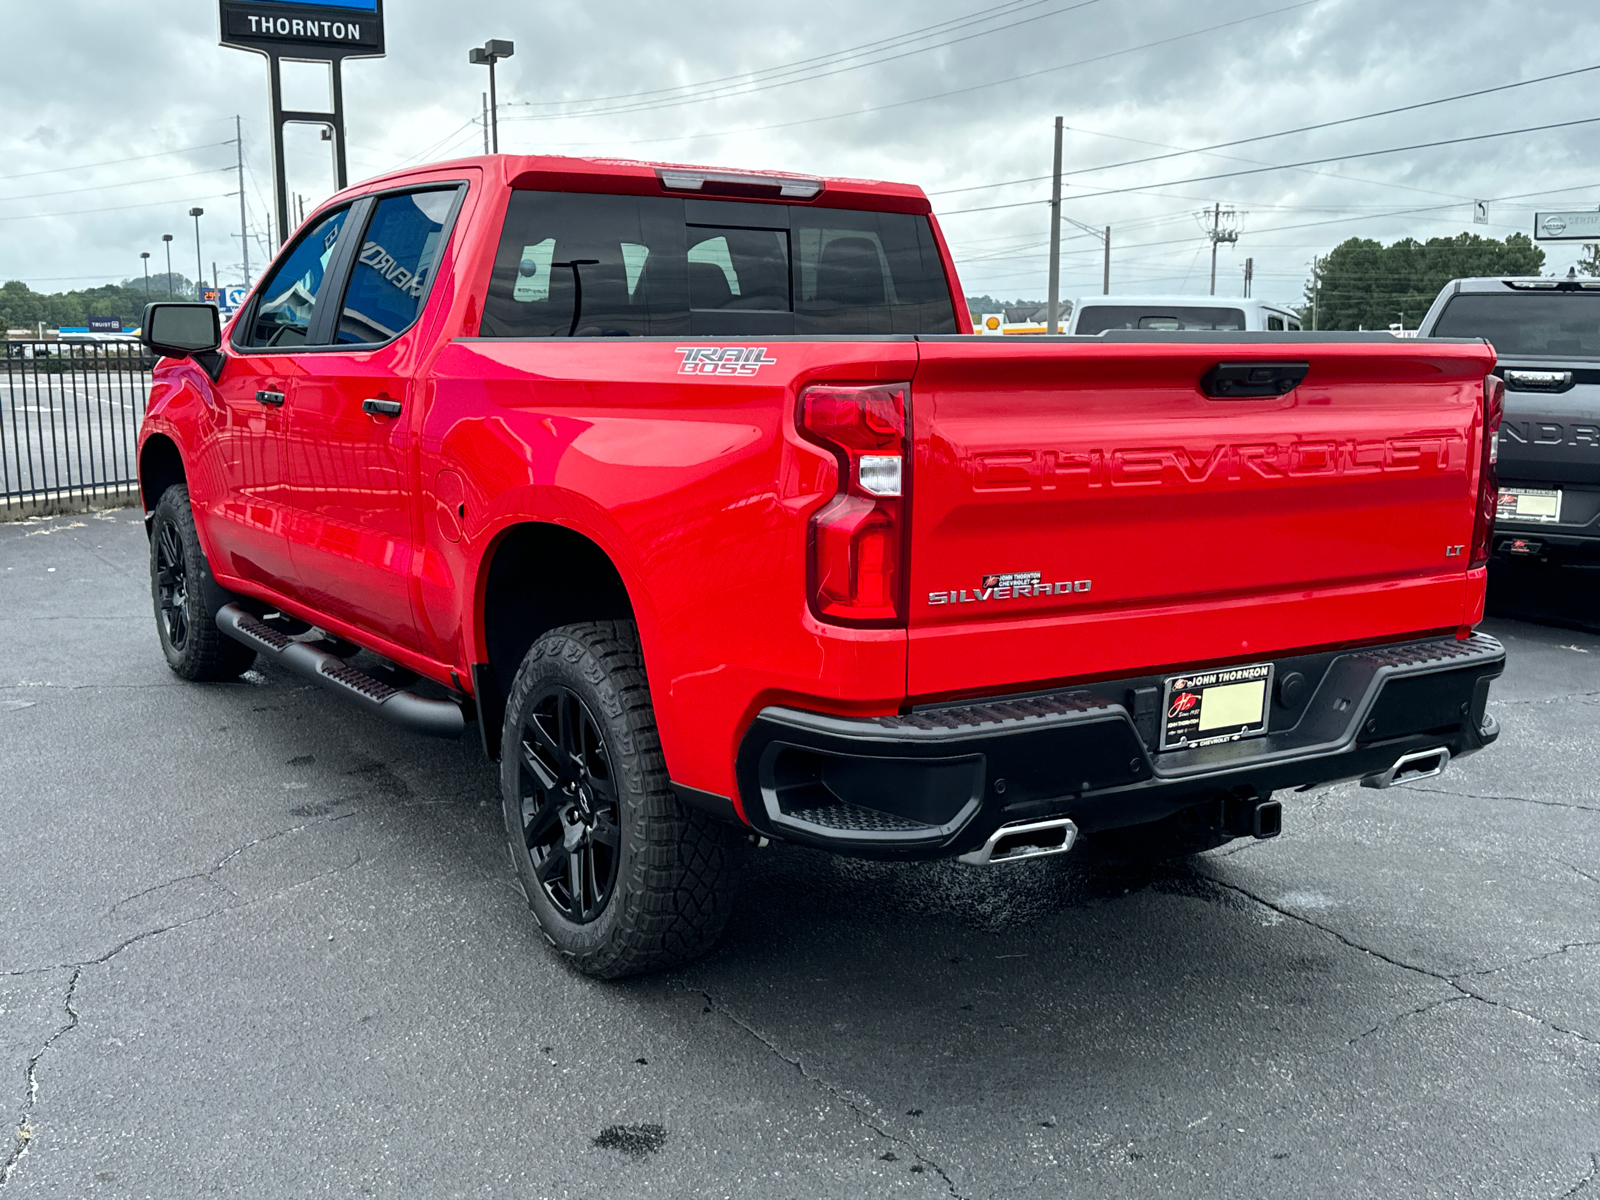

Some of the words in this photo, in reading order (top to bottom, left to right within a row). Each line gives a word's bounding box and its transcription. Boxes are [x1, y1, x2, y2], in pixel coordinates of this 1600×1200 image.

[248, 16, 360, 40] THORNTON
[675, 347, 777, 365] TRAIL
[677, 362, 760, 377] BOSS
[972, 433, 1463, 493] CHEVROLET
[1446, 544, 1465, 557] LT
[998, 579, 1031, 587] CHEVROLET
[1013, 572, 1041, 580] THORNTON
[928, 580, 1092, 606] SILVERADO
[1191, 673, 1217, 687] JOHN
[1218, 667, 1268, 682] THORNTON
[1199, 736, 1231, 747] CHEVROLET
